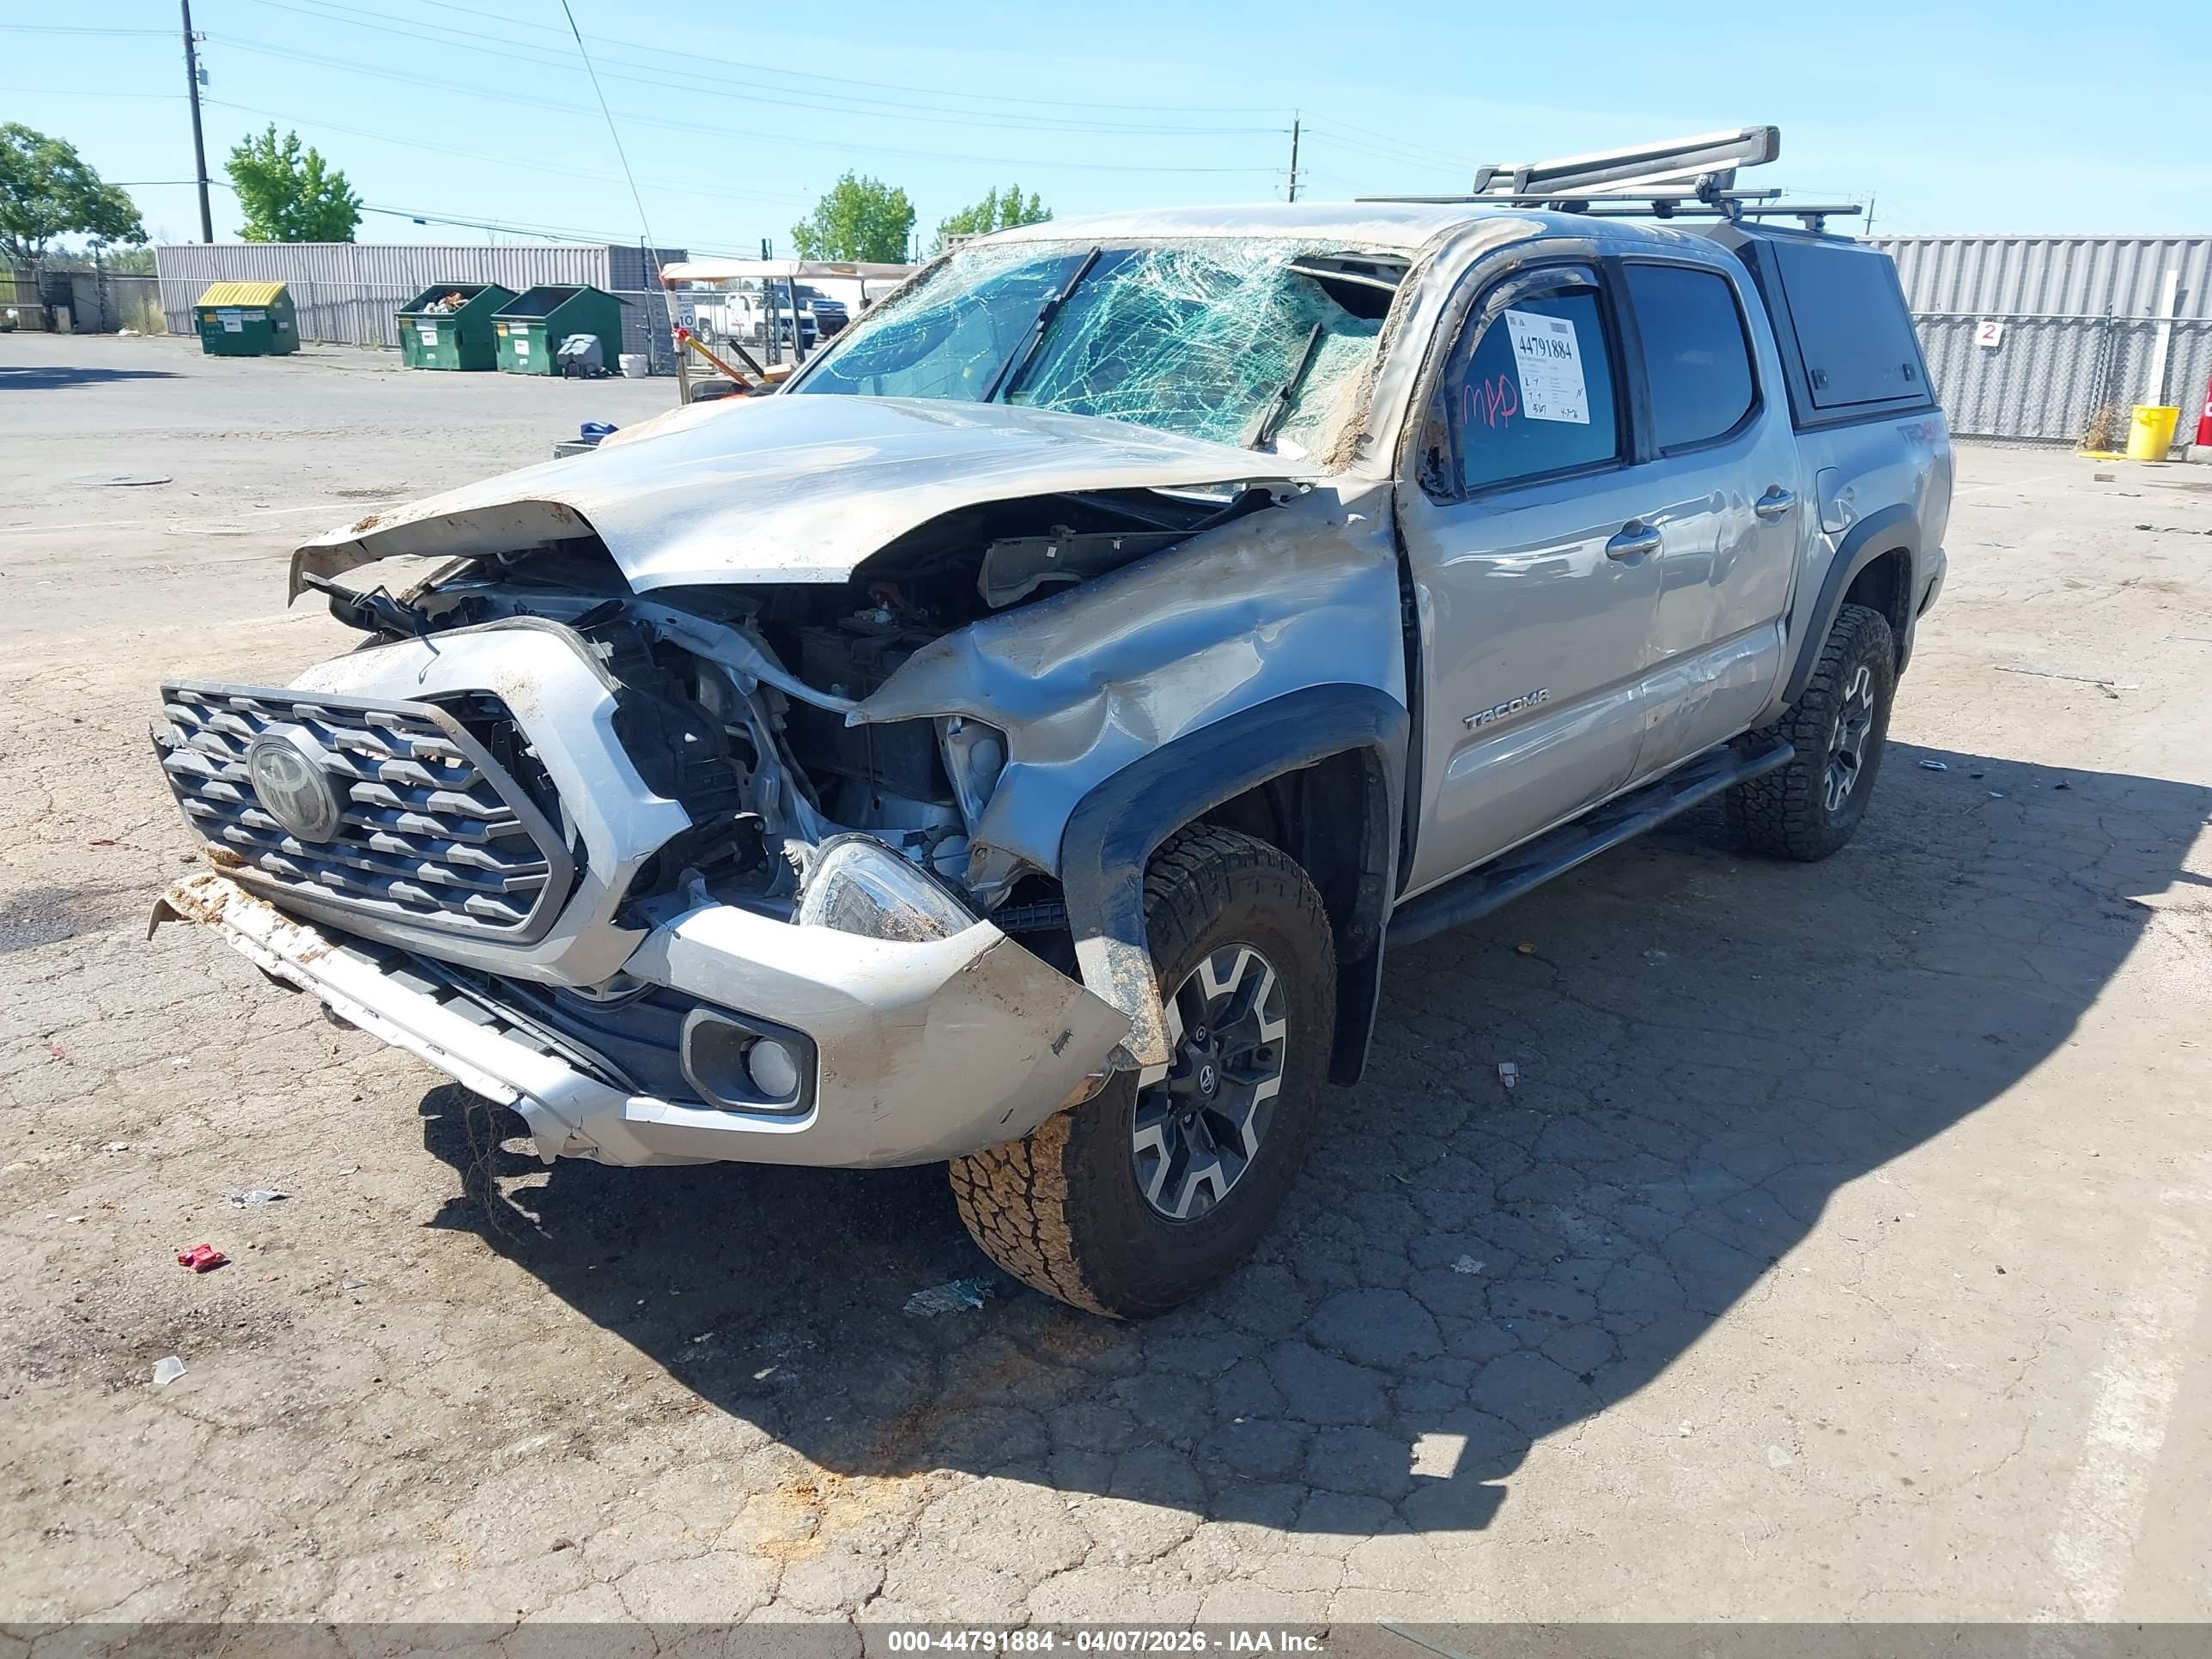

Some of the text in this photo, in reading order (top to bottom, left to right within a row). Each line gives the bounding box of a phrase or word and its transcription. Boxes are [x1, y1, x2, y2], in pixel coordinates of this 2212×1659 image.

[680, 315, 694, 326] 10
[1982, 324, 1996, 340] 2
[1519, 335, 1572, 360] 44791884
[1896, 423, 1925, 447] TRD
[1462, 688, 1551, 730] TACOMA
